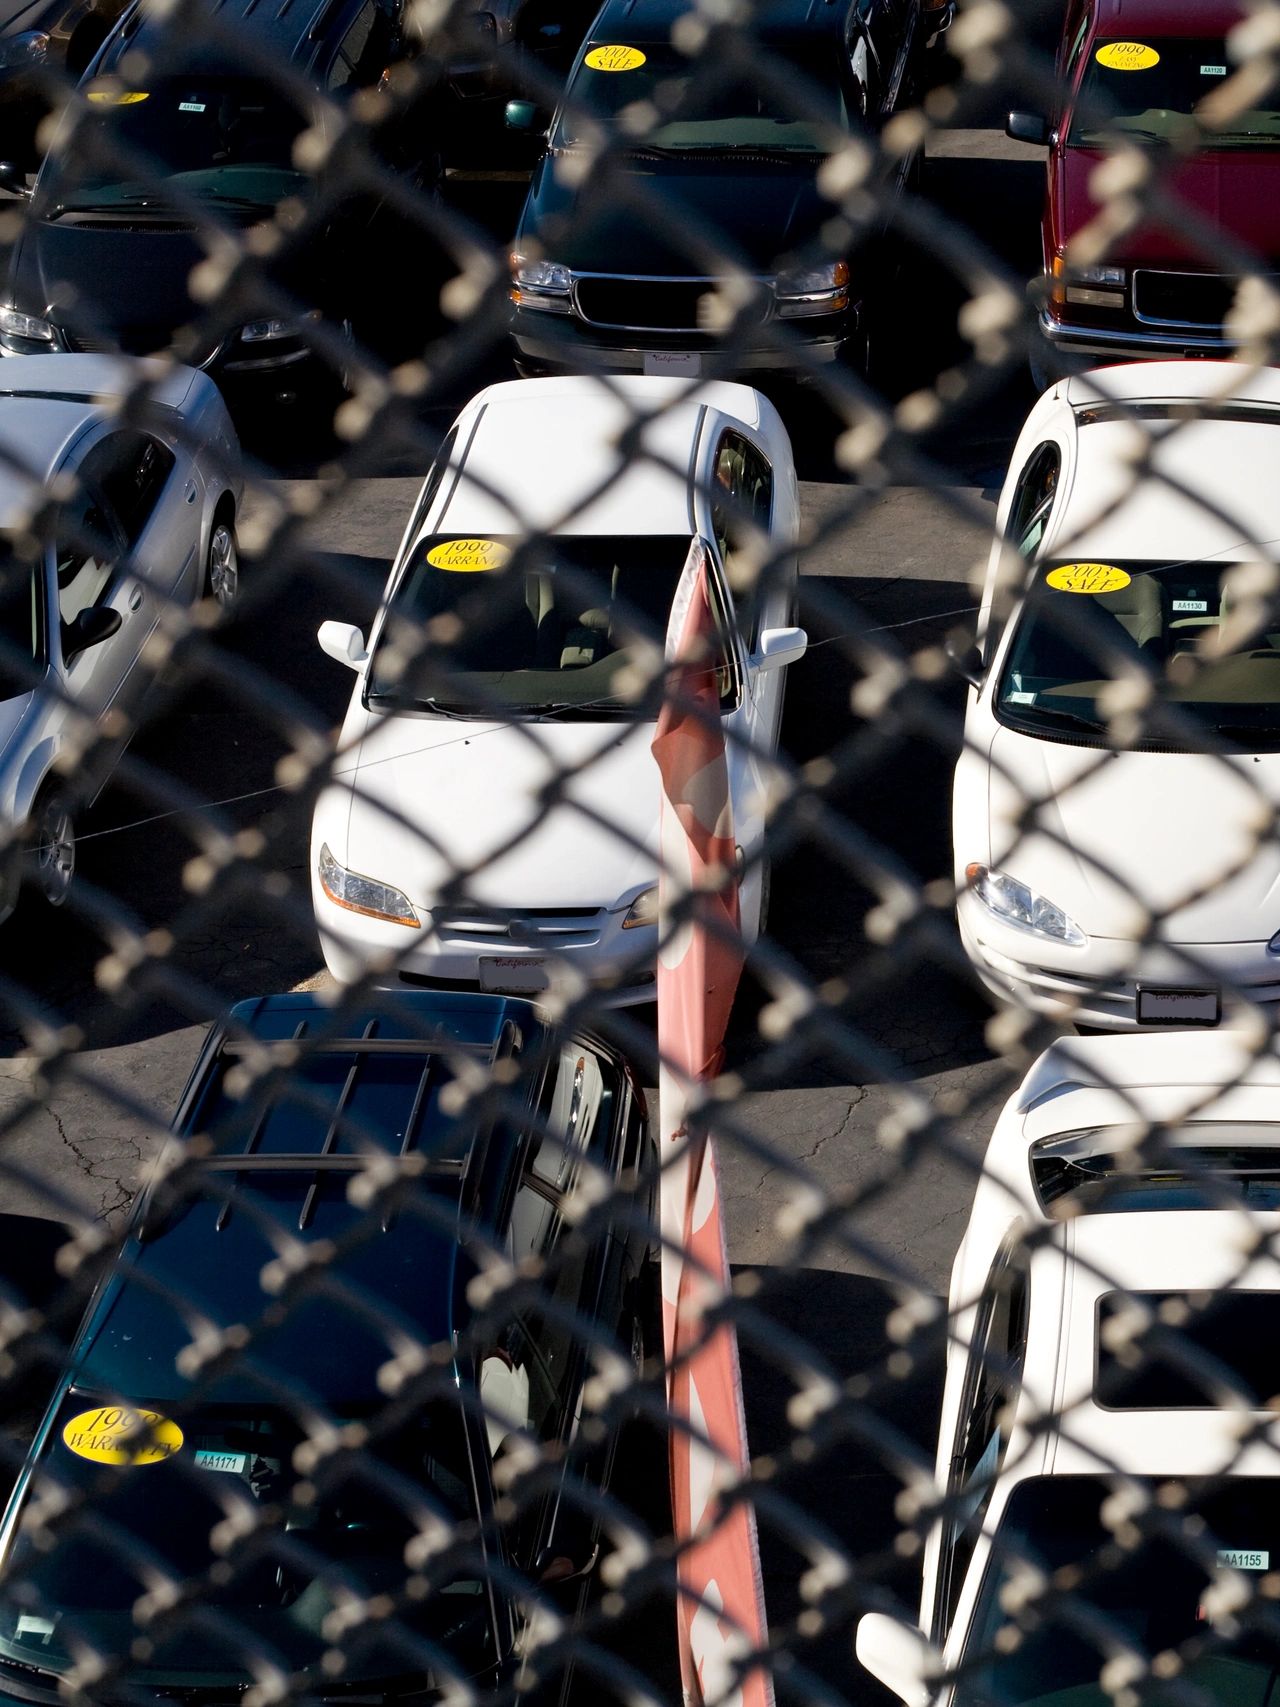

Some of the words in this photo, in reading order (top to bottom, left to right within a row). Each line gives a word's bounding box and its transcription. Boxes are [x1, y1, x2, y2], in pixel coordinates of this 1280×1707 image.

[594, 46, 632, 58] 2001
[1109, 43, 1146, 56] 1999
[594, 58, 637, 69] SALE
[445, 541, 494, 556] 1999
[1061, 565, 1115, 578] 2003
[1060, 578, 1119, 591] SALE
[1177, 602, 1203, 611] AA1130
[200, 1454, 238, 1469] AA1171
[1224, 1553, 1262, 1567] AA1155
